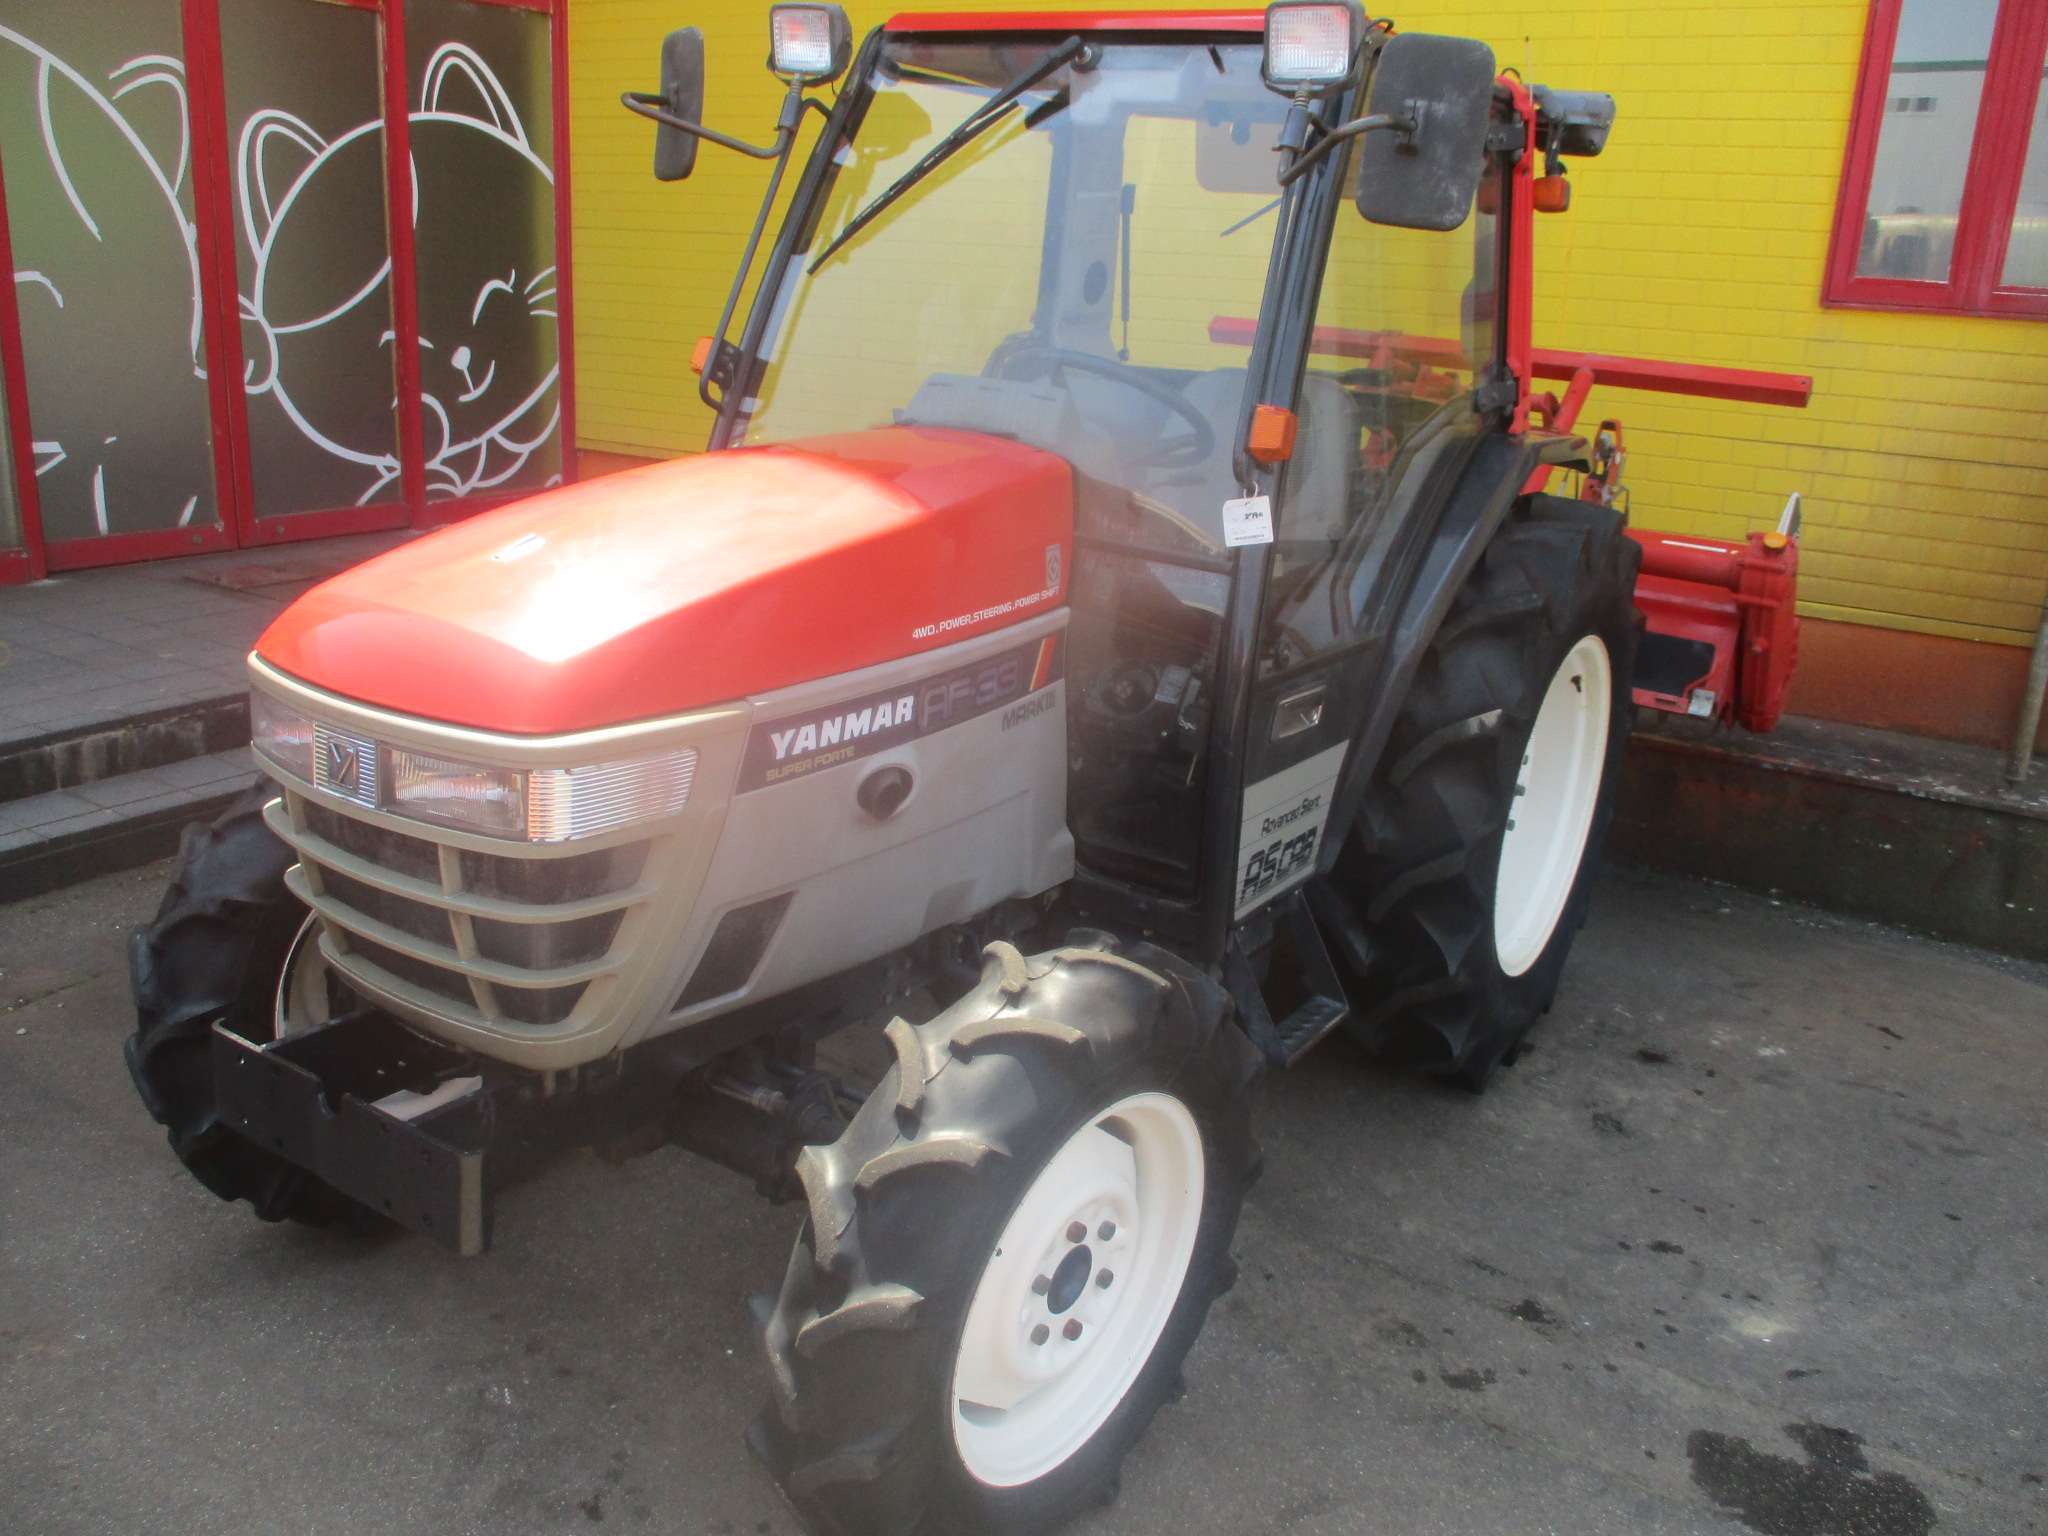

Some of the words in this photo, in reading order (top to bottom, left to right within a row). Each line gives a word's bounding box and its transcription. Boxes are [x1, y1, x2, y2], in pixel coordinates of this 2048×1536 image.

[771, 695, 915, 760] YANMAR
[766, 759, 812, 782] SUPER
[814, 746, 854, 768] FORTE
